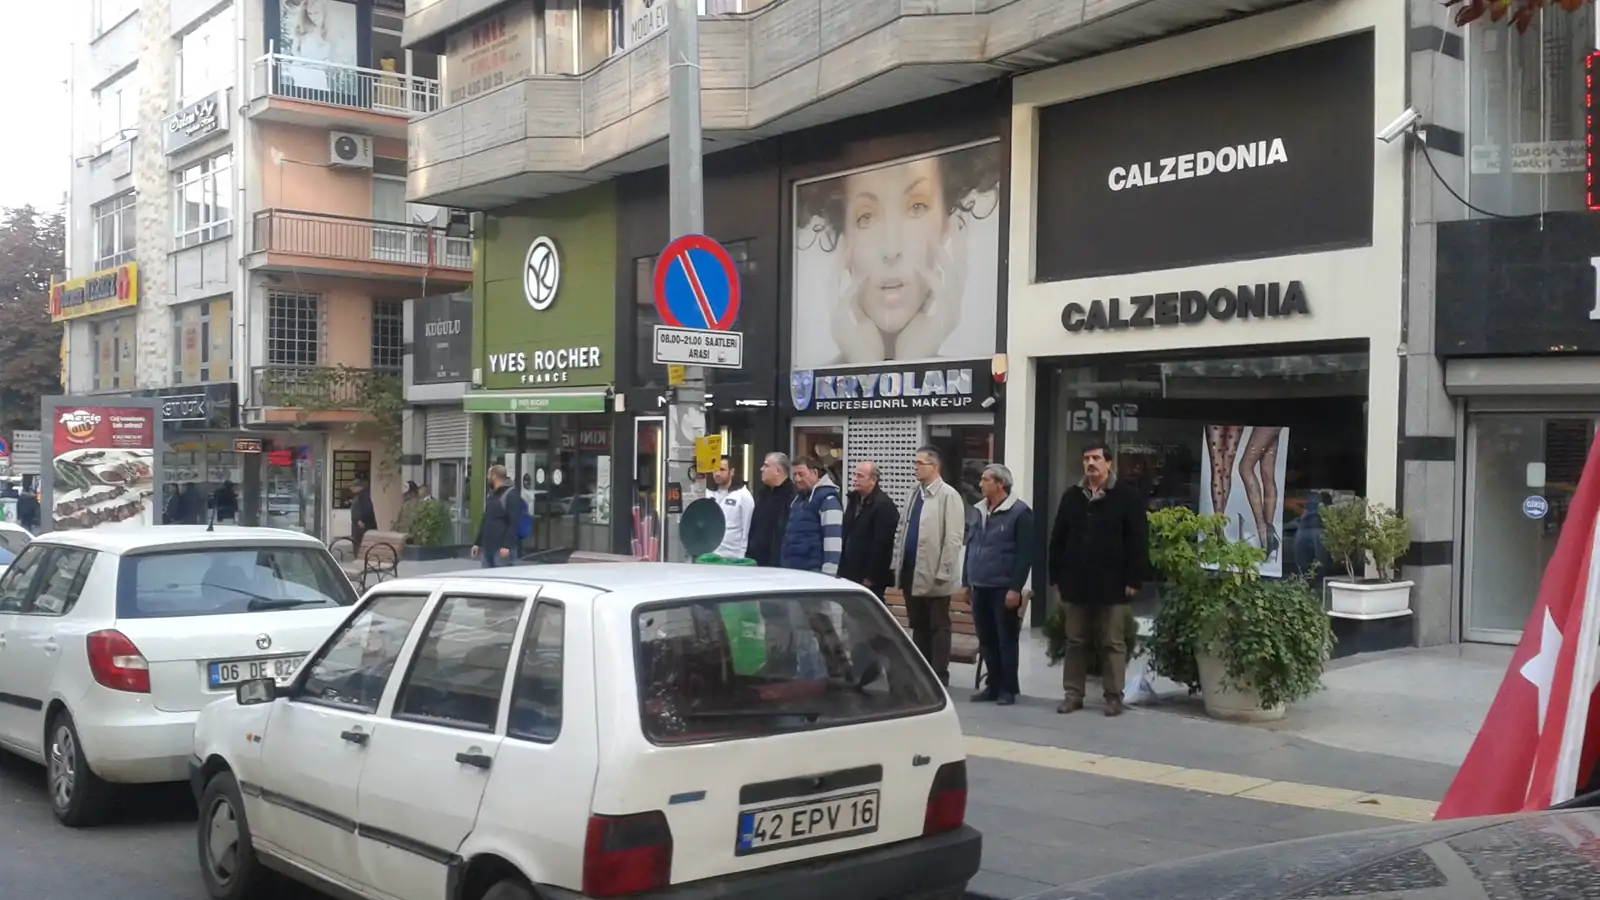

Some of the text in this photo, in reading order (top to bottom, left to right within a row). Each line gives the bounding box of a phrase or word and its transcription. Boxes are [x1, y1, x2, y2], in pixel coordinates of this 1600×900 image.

[1107, 137, 1288, 192] CALZEDONIA
[1061, 280, 1310, 332] CALZEDONIA
[488, 346, 601, 373] YVES ROCHER
[688, 348, 710, 360] ARASI
[521, 371, 568, 384] FRANCE
[815, 368, 973, 400] KRYOLAN
[816, 396, 972, 411] PROFESSIONAL MAKE-UP
[221, 664, 239, 681] 06
[249, 662, 268, 678] DE
[754, 799, 874, 842] 42 EPV 16
